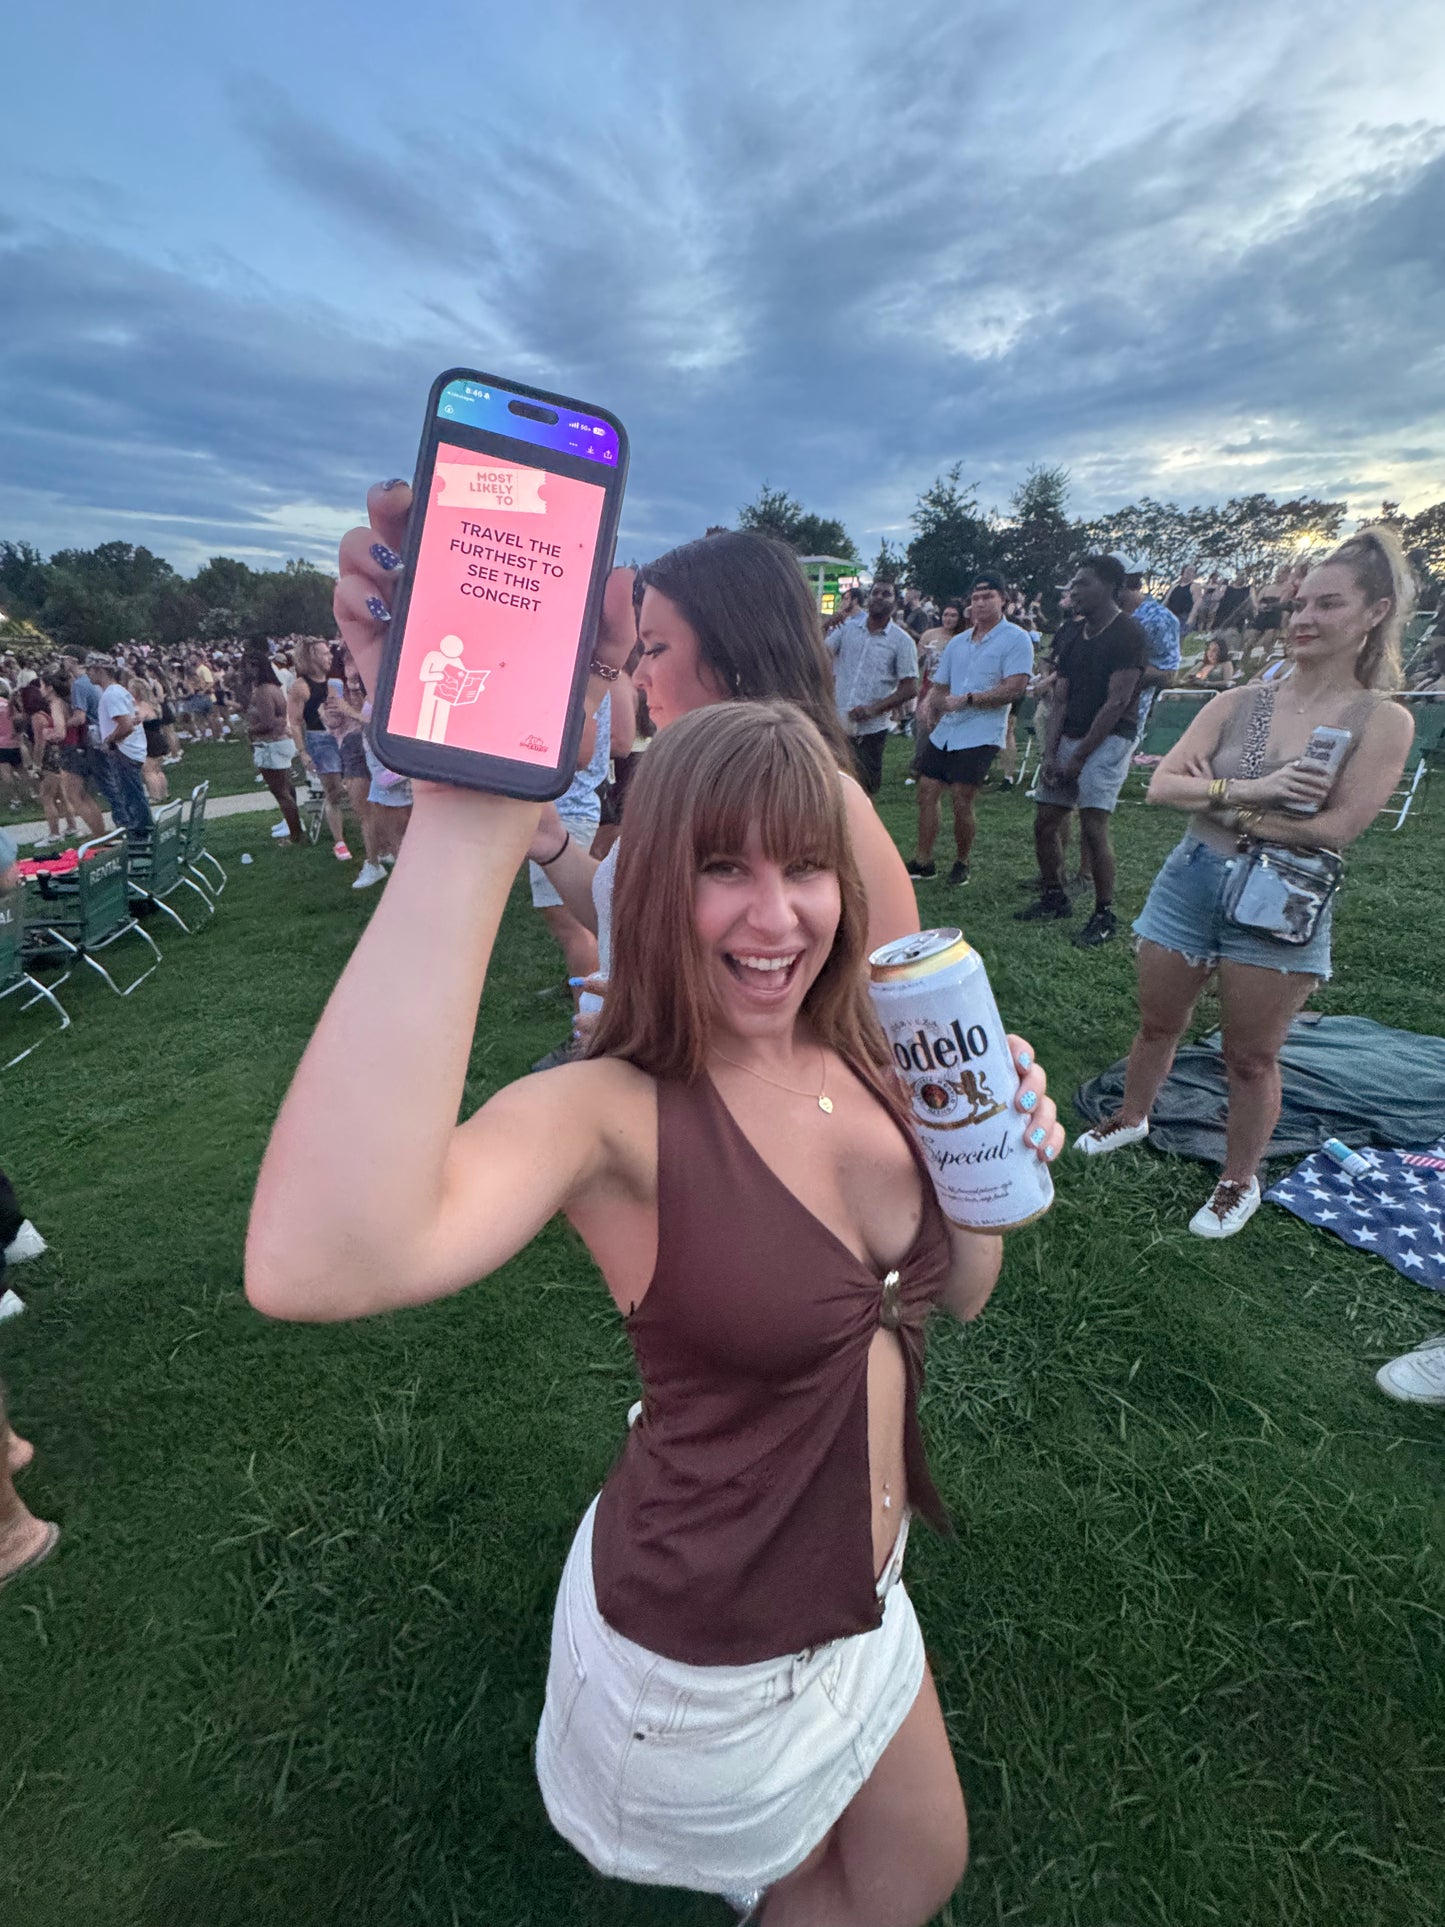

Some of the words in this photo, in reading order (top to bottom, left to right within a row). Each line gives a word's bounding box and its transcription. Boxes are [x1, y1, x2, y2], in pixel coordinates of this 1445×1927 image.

[470, 483, 513, 495] LIKELY
[477, 472, 513, 484] MOST
[496, 495, 513, 506] TO
[461, 520, 524, 549] TRAVEL
[529, 539, 562, 558] THE
[450, 539, 538, 571] FURTHEST
[542, 562, 564, 578] TO
[467, 564, 499, 582] SEE
[503, 572, 540, 592] THIS
[460, 582, 542, 612] CONCERT
[892, 1019, 989, 1072] odelo
